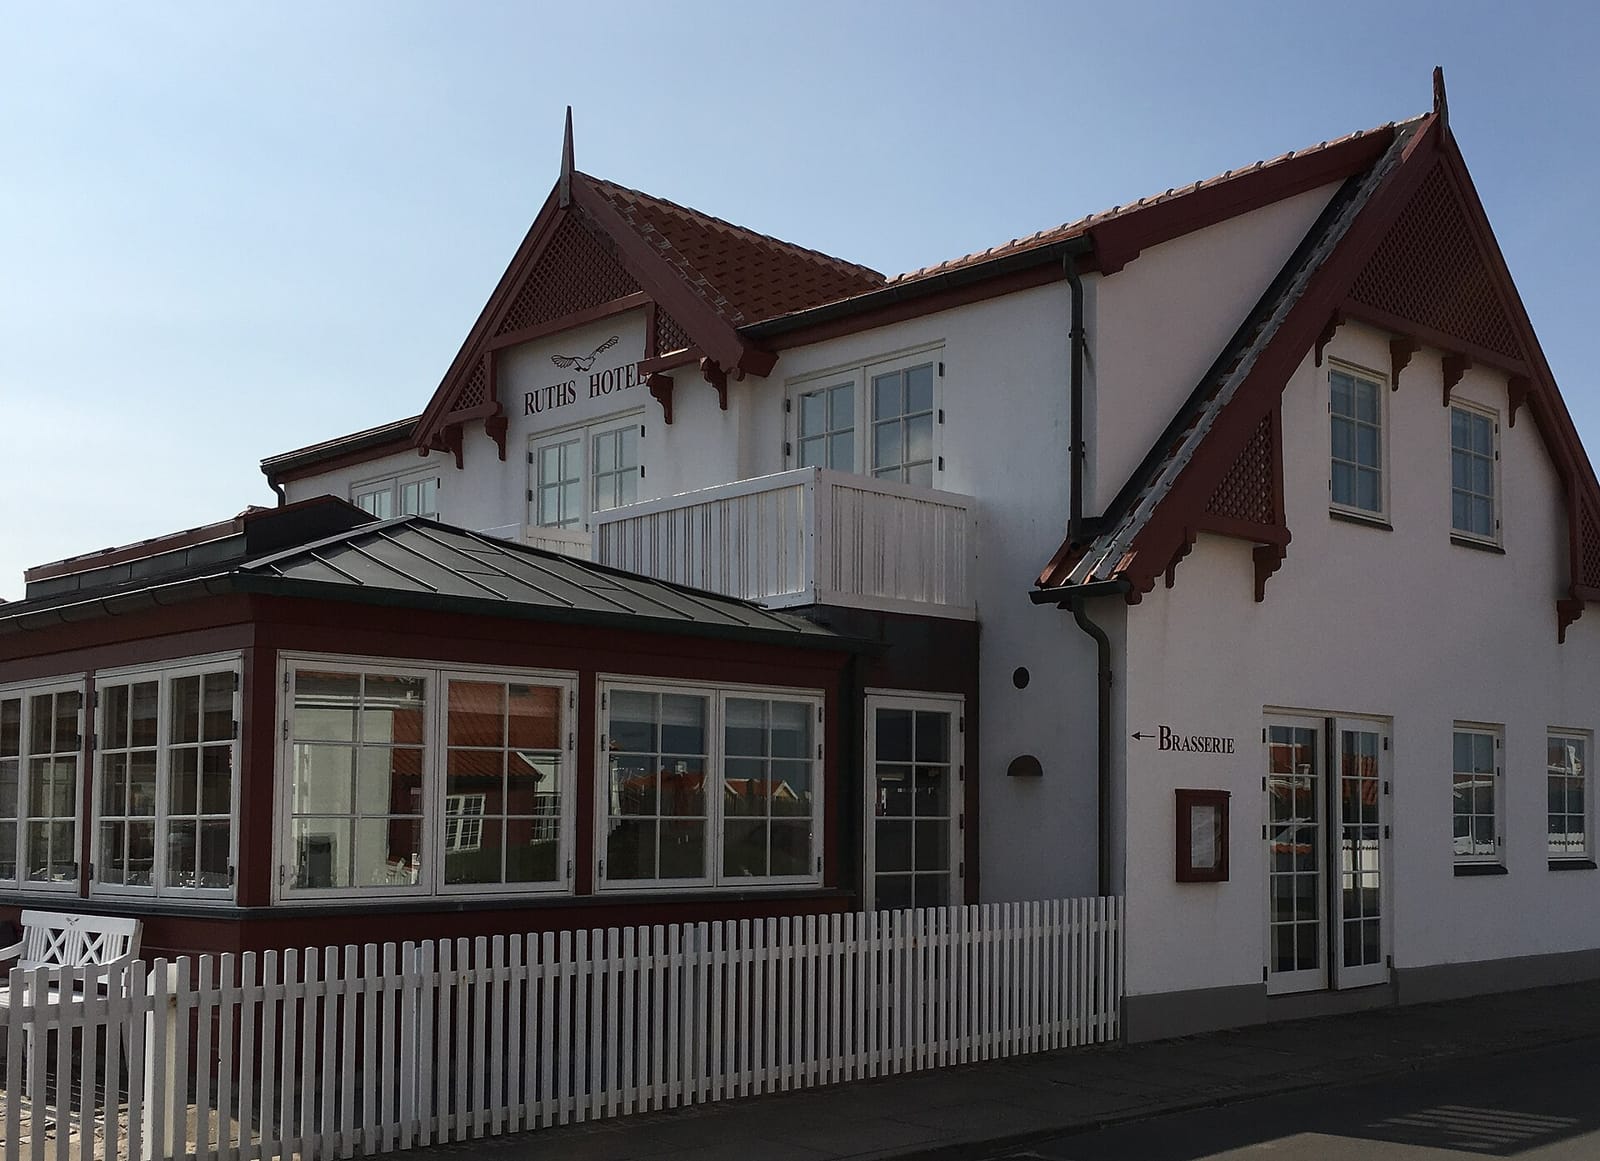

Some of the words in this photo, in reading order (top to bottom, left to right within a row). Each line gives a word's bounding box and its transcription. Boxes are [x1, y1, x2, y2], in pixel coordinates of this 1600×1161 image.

[524, 380, 577, 416] RUTHS
[589, 362, 647, 398] HOTEL
[1158, 725, 1235, 754] BRASSERIE
